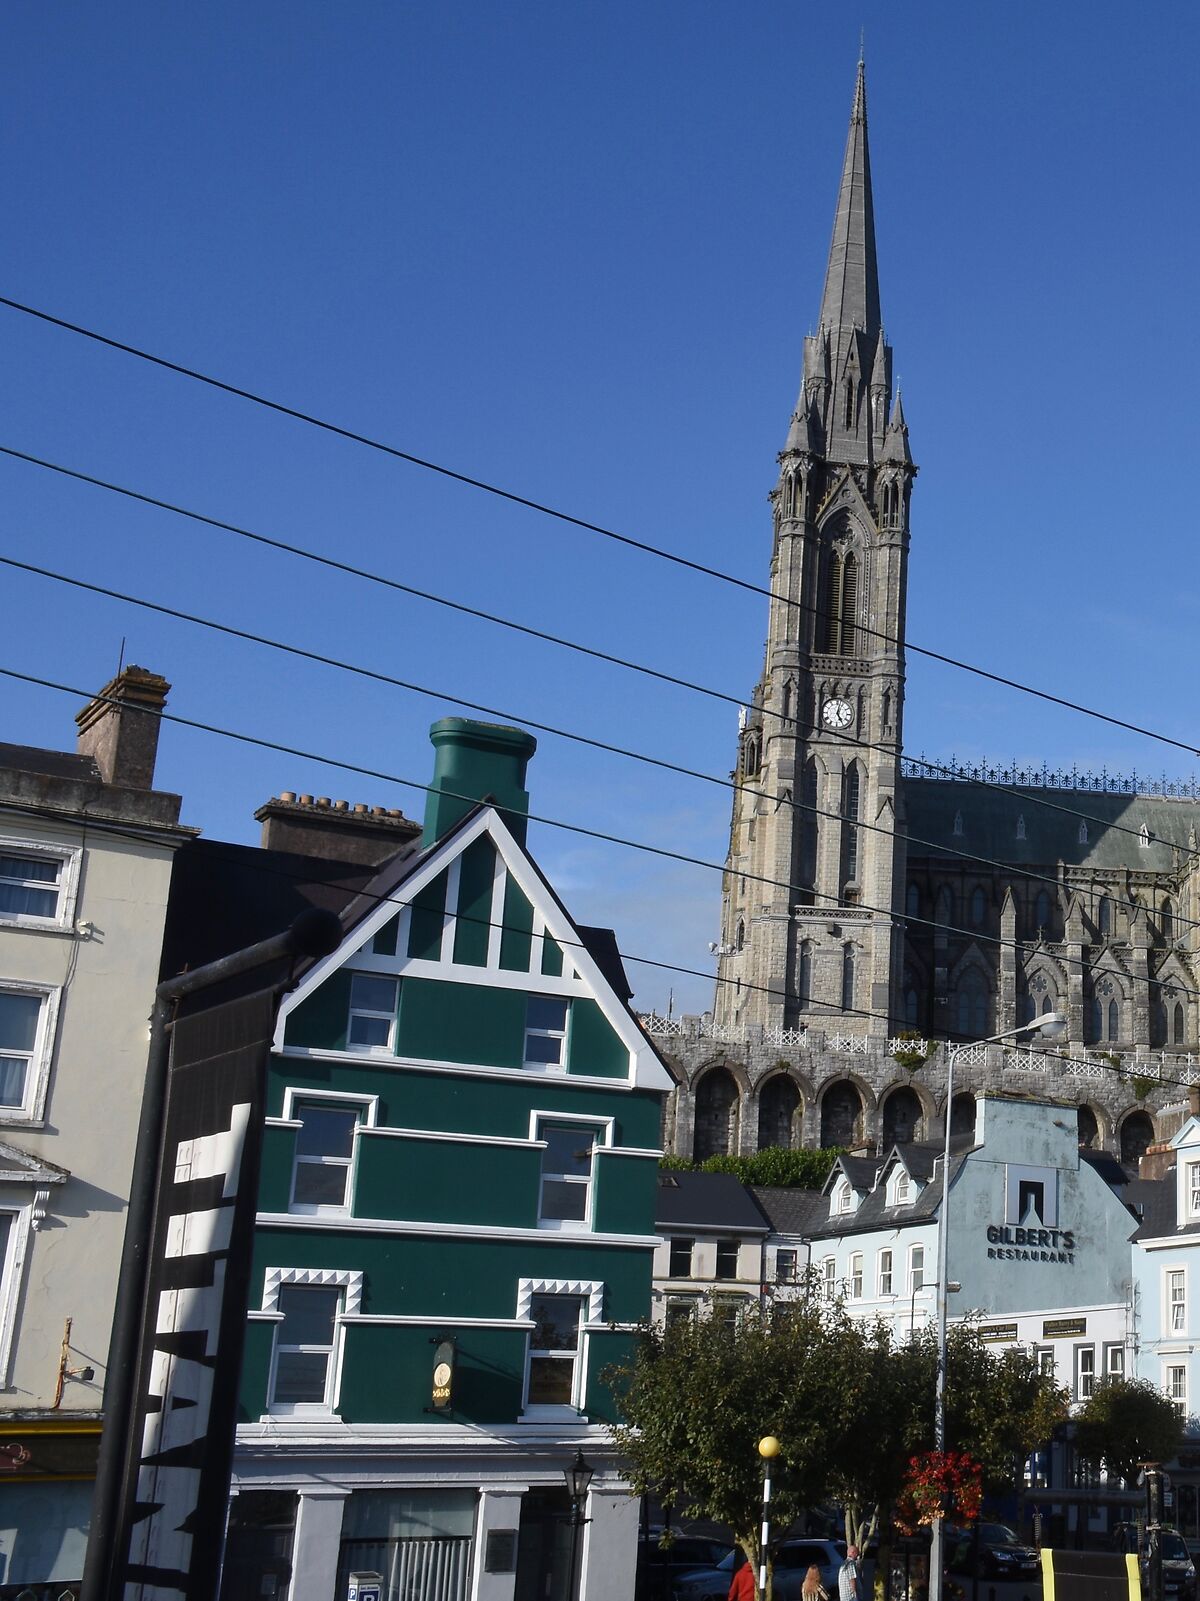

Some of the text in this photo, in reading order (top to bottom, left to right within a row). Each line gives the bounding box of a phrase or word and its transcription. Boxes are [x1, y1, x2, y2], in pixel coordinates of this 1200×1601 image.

[987, 1225, 1076, 1249] GILBERT'S
[987, 1248, 1076, 1264] RESTAURANT
[350, 1589, 356, 1598] P
